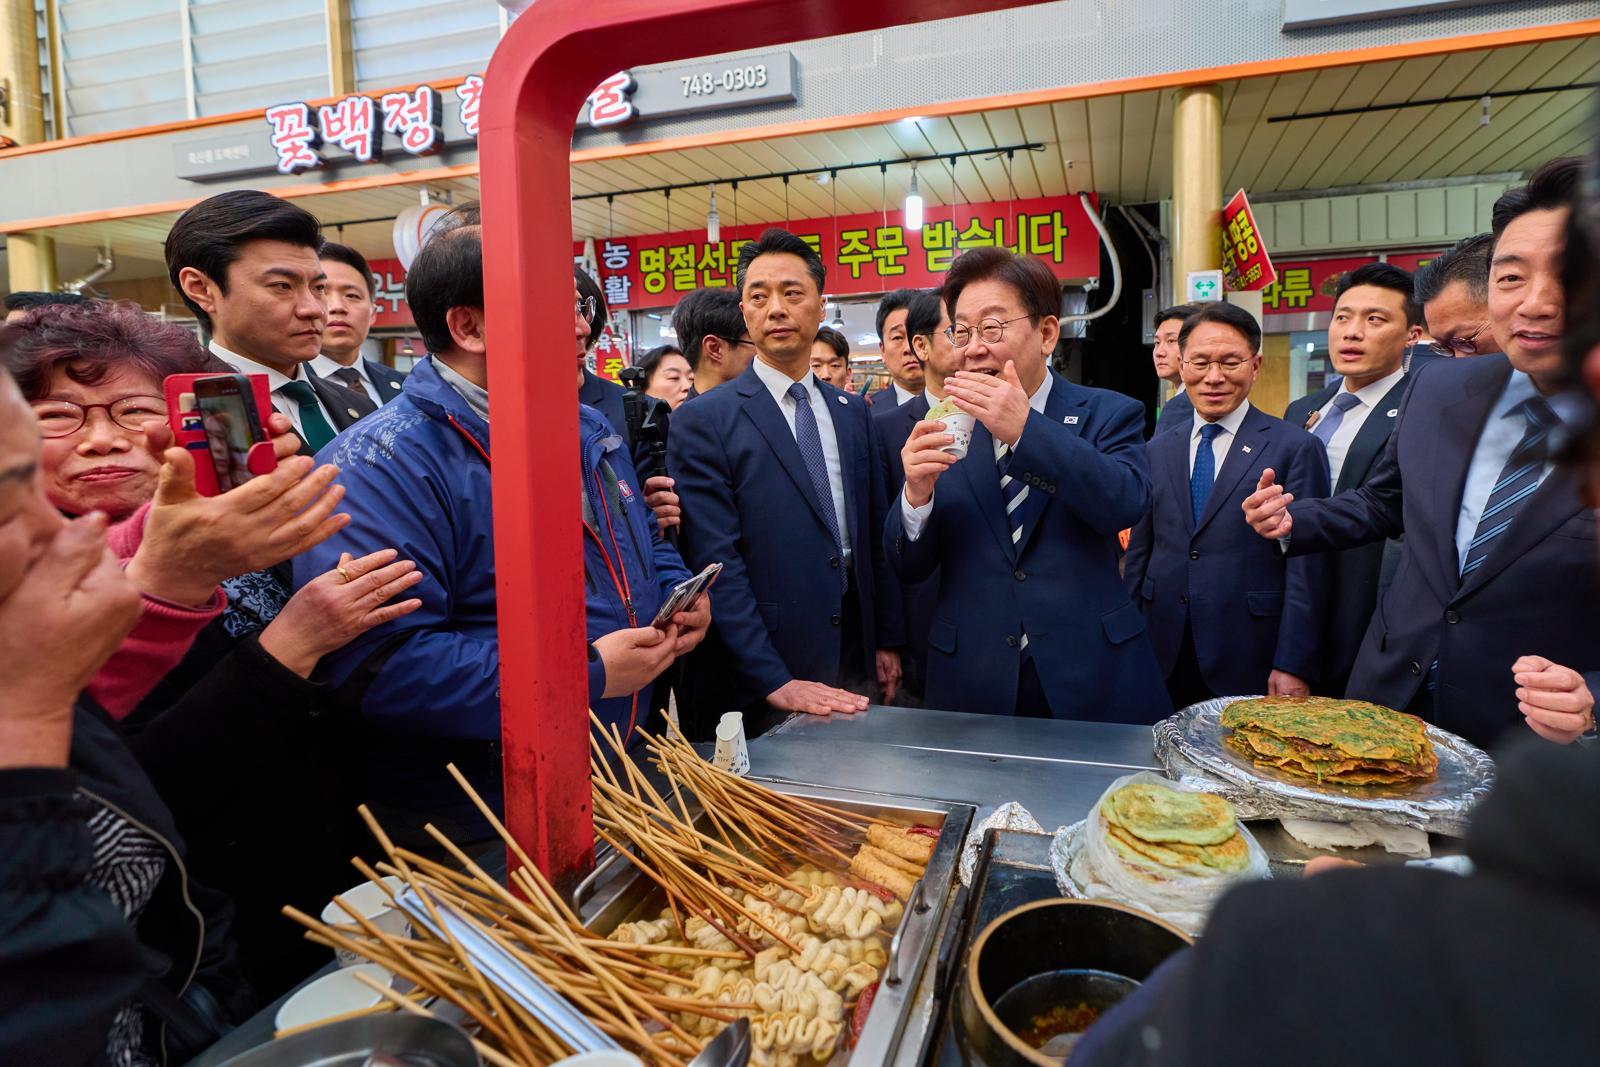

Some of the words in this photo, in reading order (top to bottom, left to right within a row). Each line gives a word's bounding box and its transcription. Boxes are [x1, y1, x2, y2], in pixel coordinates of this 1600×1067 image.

[680, 64, 767, 97] 748-0303
[266, 85, 437, 174] 꽃백정
[640, 234, 825, 295] 명절선
[838, 225, 909, 279] 주문
[922, 211, 1068, 273] 받습니다
